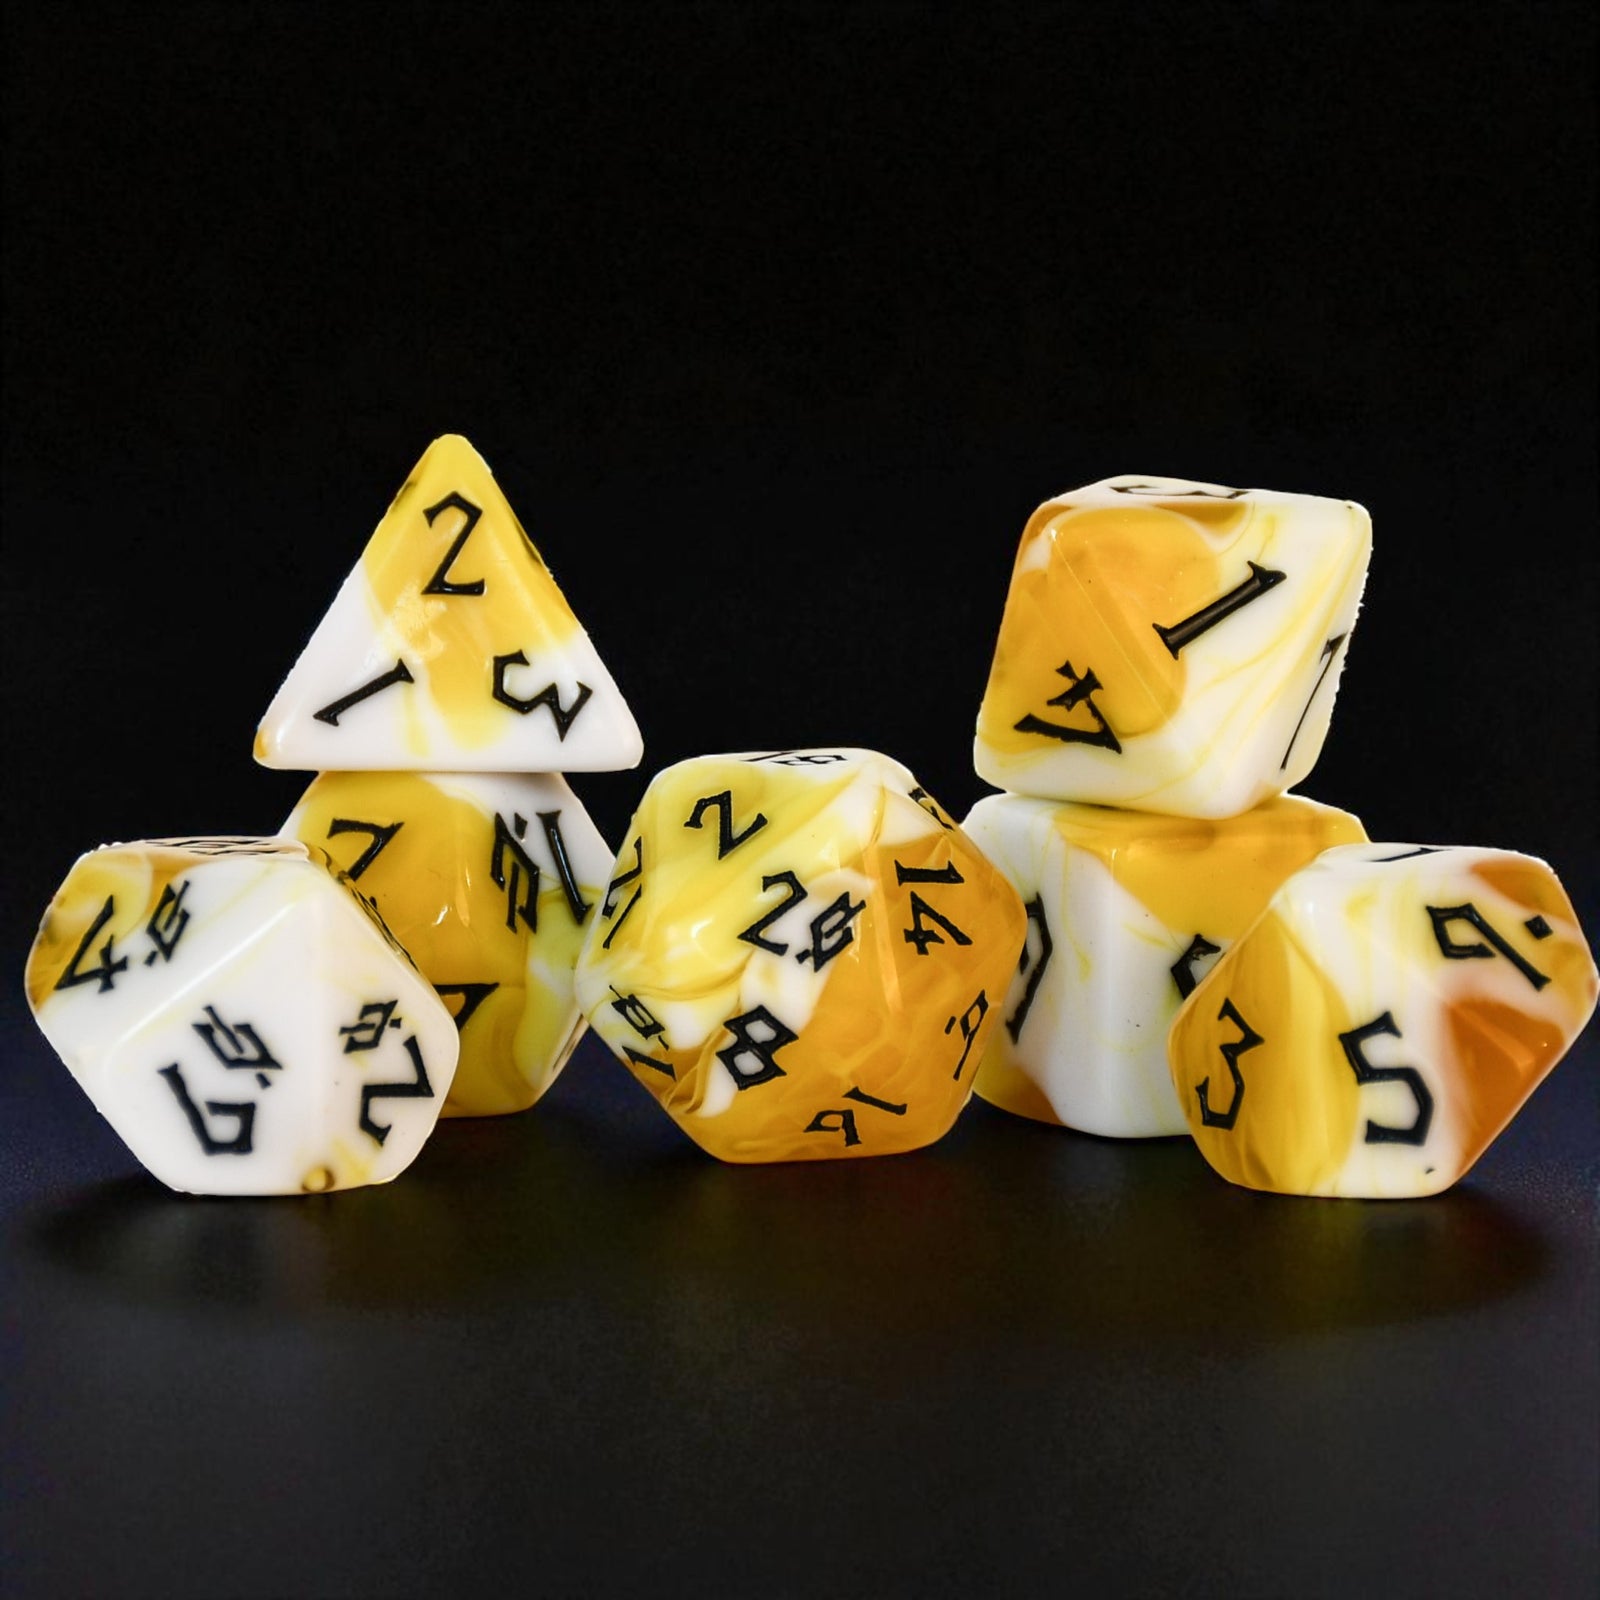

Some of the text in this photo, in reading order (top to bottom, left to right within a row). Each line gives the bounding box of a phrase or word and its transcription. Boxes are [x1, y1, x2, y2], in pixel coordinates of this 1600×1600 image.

[420, 491, 486, 596] 2
[1152, 561, 1287, 660] 1
[313, 658, 414, 727] 1
[491, 649, 593, 742] 3
[1013, 660, 1122, 754] 4
[683, 790, 768, 860] 2
[894, 859, 973, 955] 14
[715, 1004, 799, 1091] 8
[1195, 998, 1265, 1131] 3
[1338, 1011, 1434, 1146] 5
